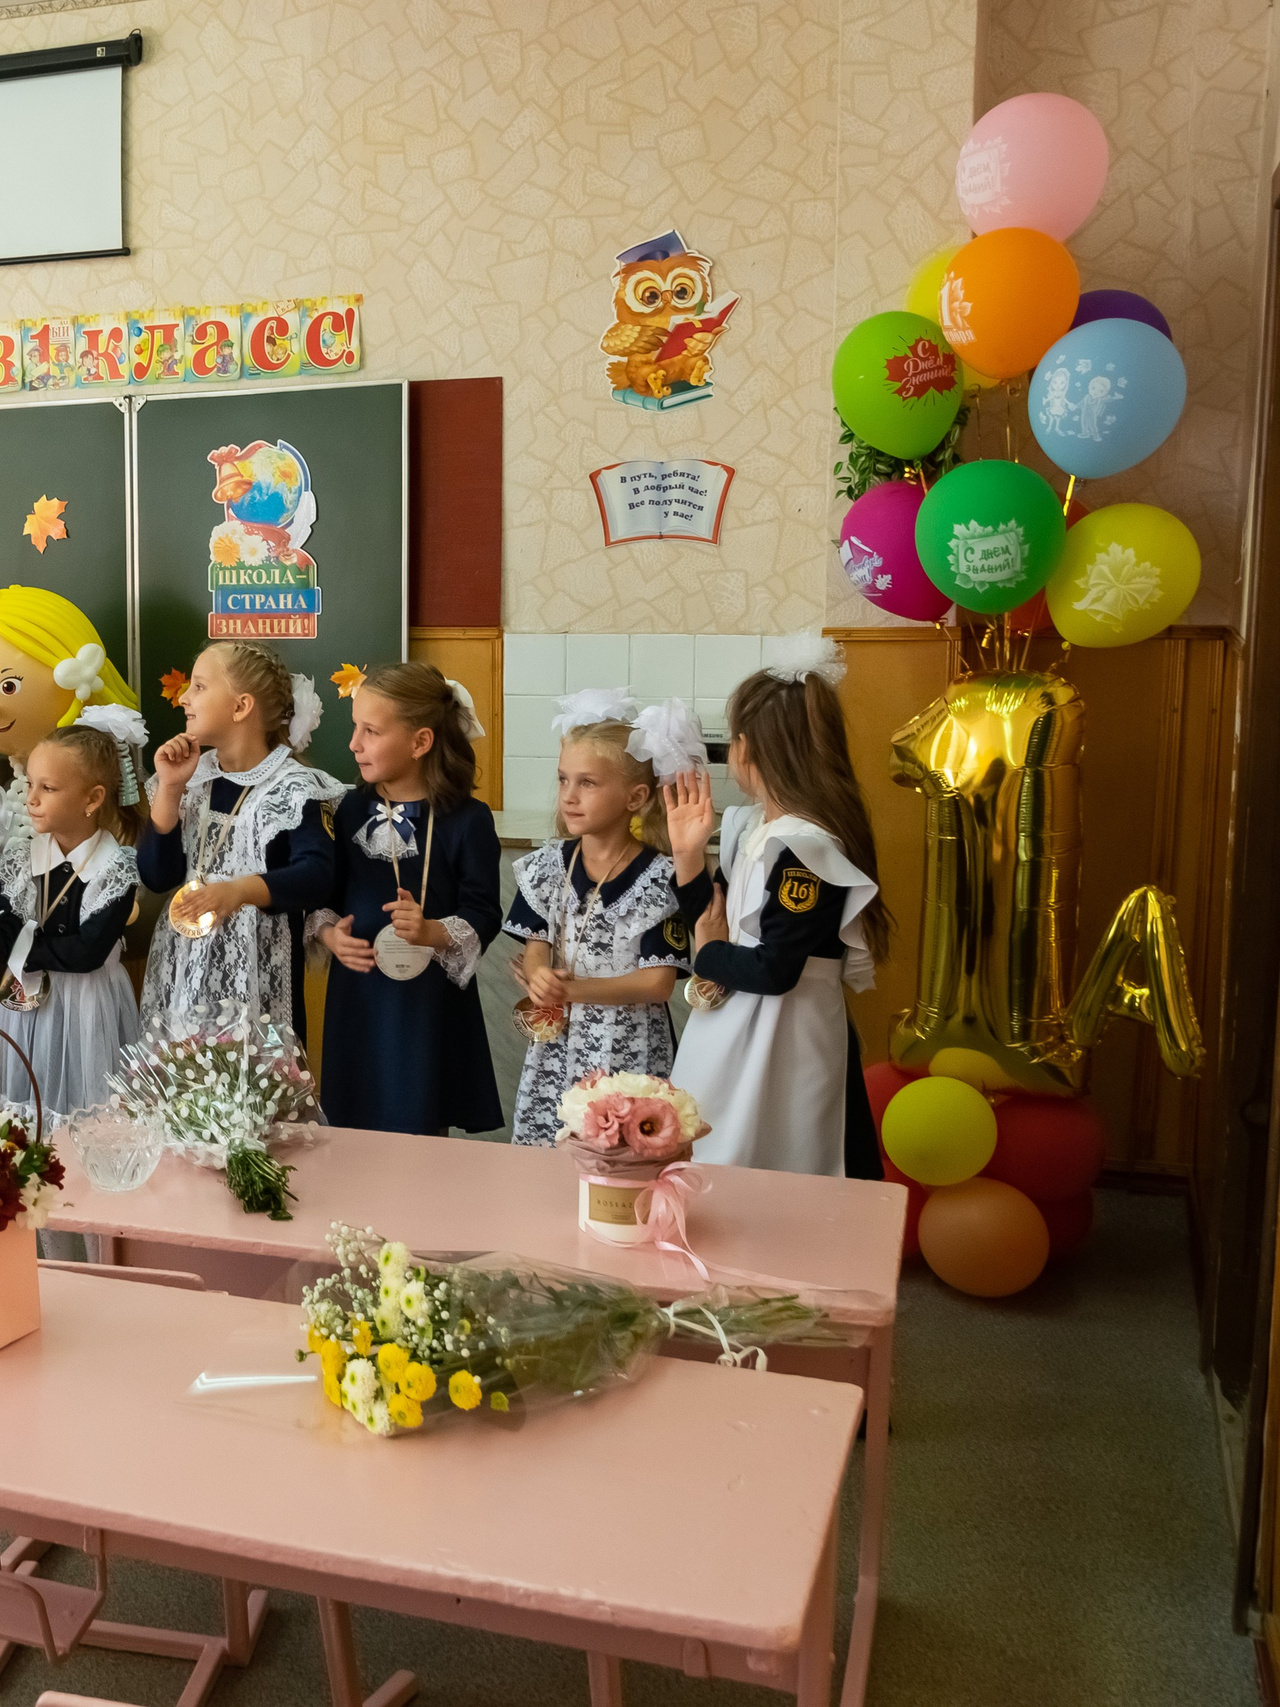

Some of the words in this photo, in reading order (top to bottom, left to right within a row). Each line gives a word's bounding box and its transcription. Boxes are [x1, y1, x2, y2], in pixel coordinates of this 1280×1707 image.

[29, 324, 58, 390] 1
[81, 307, 356, 382] класс!
[917, 340, 930, 358] С
[620, 476, 627, 484] В
[630, 472, 658, 482] путь,
[661, 470, 700, 481] ребята!
[632, 487, 641, 495] В
[643, 482, 685, 493] добрый
[688, 485, 708, 497] час!
[628, 500, 645, 511] Все
[648, 498, 705, 512] получится
[663, 510, 670, 518] у
[673, 510, 694, 521] вас!
[963, 547, 975, 563] С
[979, 545, 1012, 561] ДНЕМ
[965, 558, 1014, 575] ЗНАНИЙ!
[227, 593, 308, 610] СТРАНА
[217, 615, 309, 634] ЗНАНИЙ!
[790, 881, 809, 899] 16
[890, 668, 1090, 1096] 1
[597, 1199, 647, 1209] ROSEAZ
